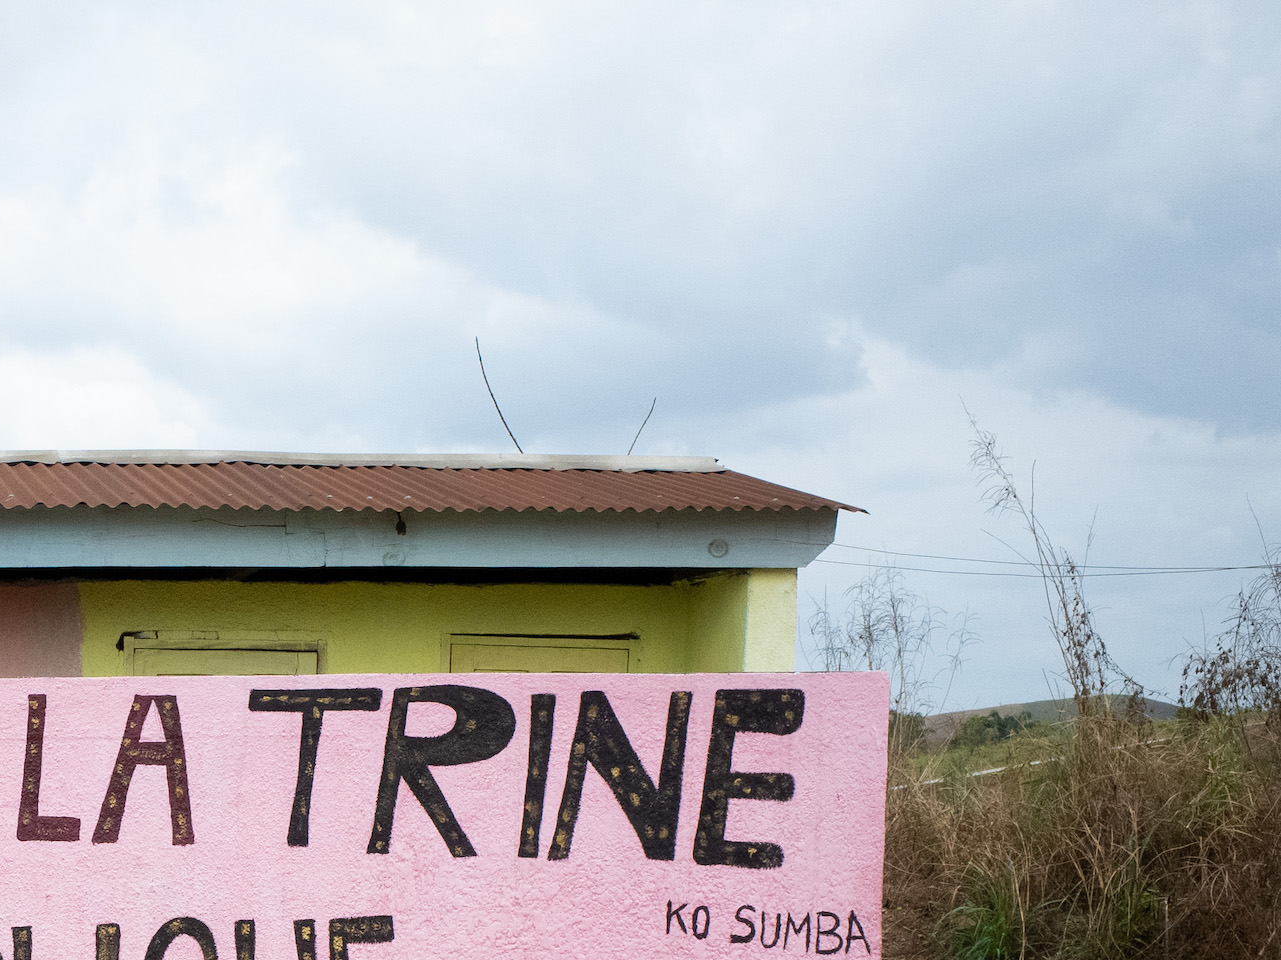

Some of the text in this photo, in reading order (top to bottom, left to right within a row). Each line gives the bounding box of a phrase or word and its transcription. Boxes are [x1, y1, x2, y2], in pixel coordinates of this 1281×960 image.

[248, 683, 806, 870] TRINE
[665, 899, 871, 956] KO SUMBA
